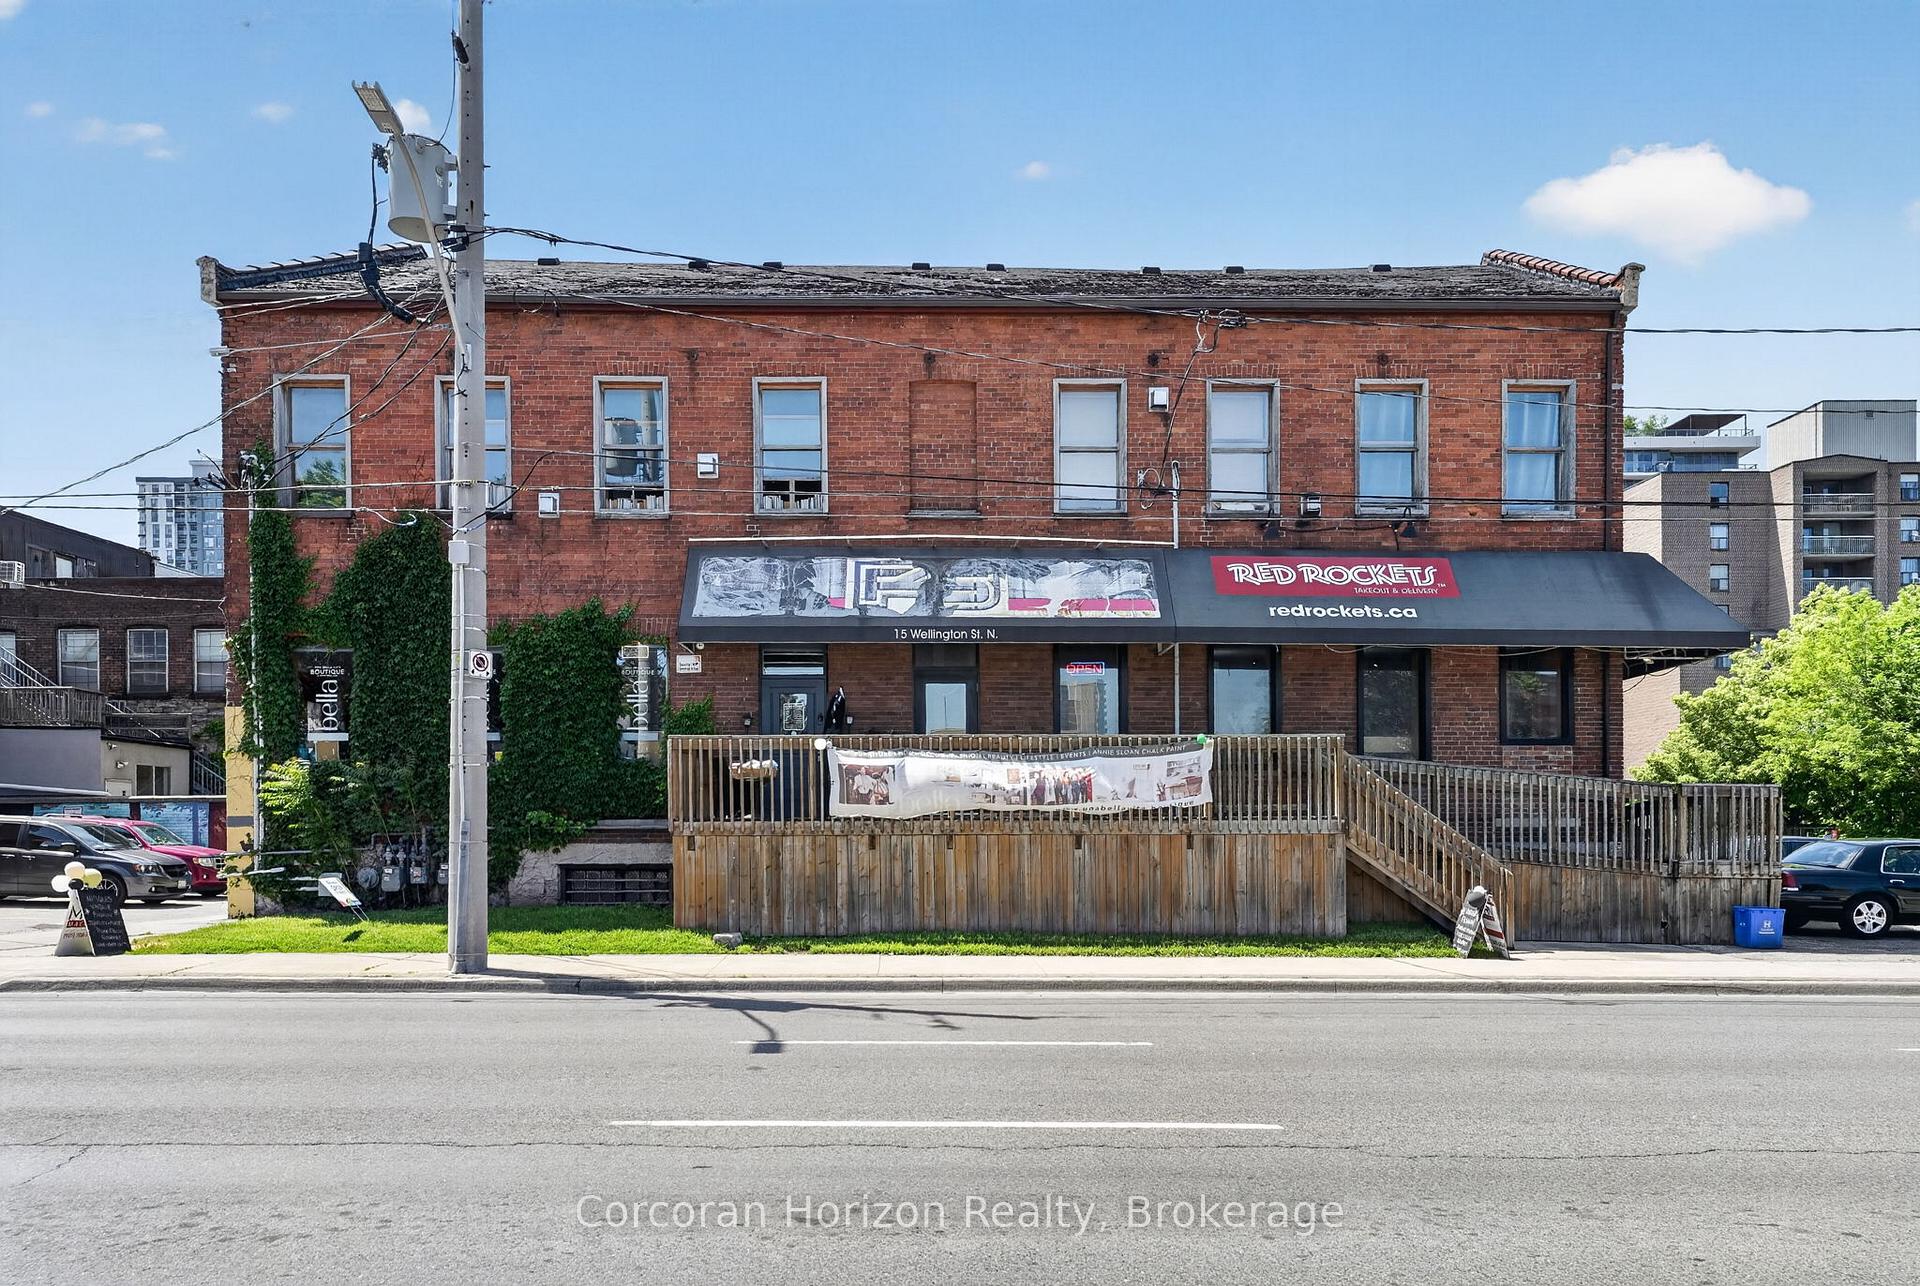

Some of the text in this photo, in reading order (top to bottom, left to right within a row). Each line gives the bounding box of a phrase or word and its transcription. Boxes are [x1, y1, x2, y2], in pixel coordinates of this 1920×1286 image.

[1227, 562, 1296, 586] RED
[1297, 563, 1438, 587] ROCKETS
[1269, 604, 1418, 618] redrockets.ca
[894, 628, 998, 642] 15 Wellington St. N.
[1066, 664, 1102, 674] OPEN
[315, 679, 339, 731] bella
[626, 680, 649, 731] bella
[1060, 751, 1086, 760] EVENTS
[1116, 748, 1140, 756] SLOAN
[1141, 746, 1164, 755] CHALK
[1166, 744, 1186, 753] PAINT
